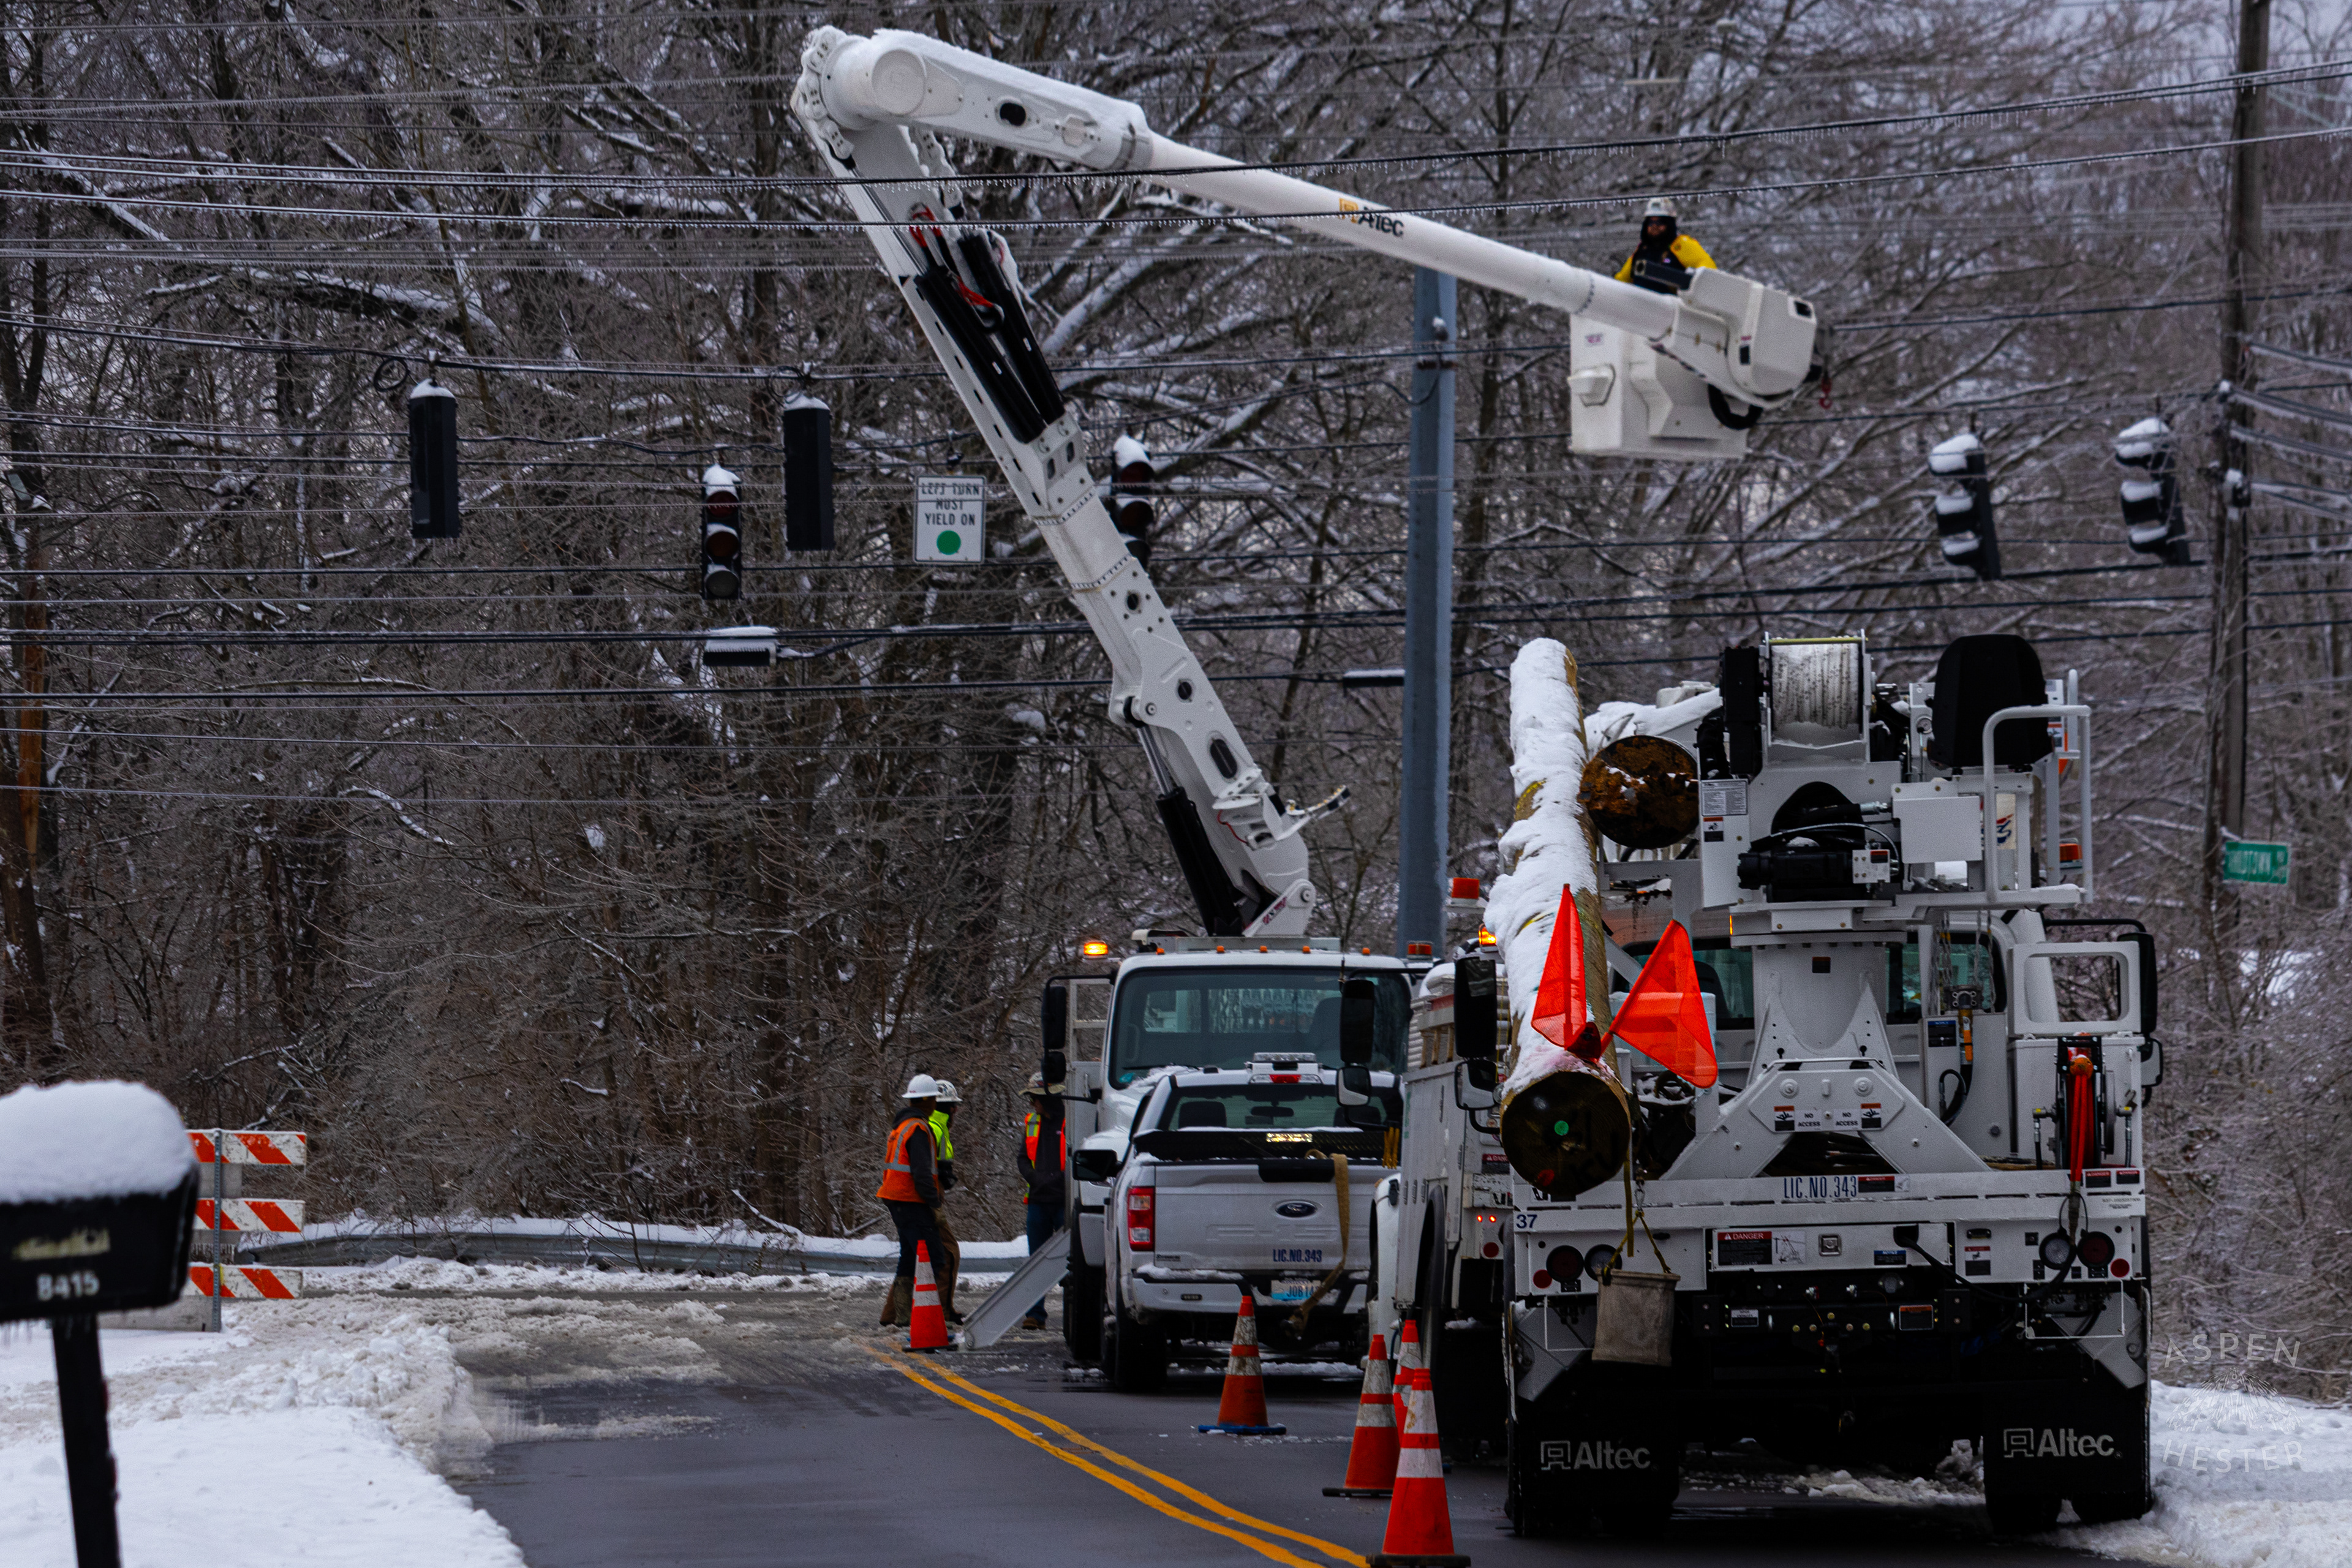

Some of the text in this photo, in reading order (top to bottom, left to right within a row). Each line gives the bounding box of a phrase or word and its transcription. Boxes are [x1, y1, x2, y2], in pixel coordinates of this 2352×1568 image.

[921, 482, 979, 496] LEFT TURN
[924, 513, 976, 526] YIELD ON
[1516, 1214, 1537, 1229] 37
[2037, 1428, 2115, 1458] Altec
[1573, 1440, 1651, 1470] Altec
